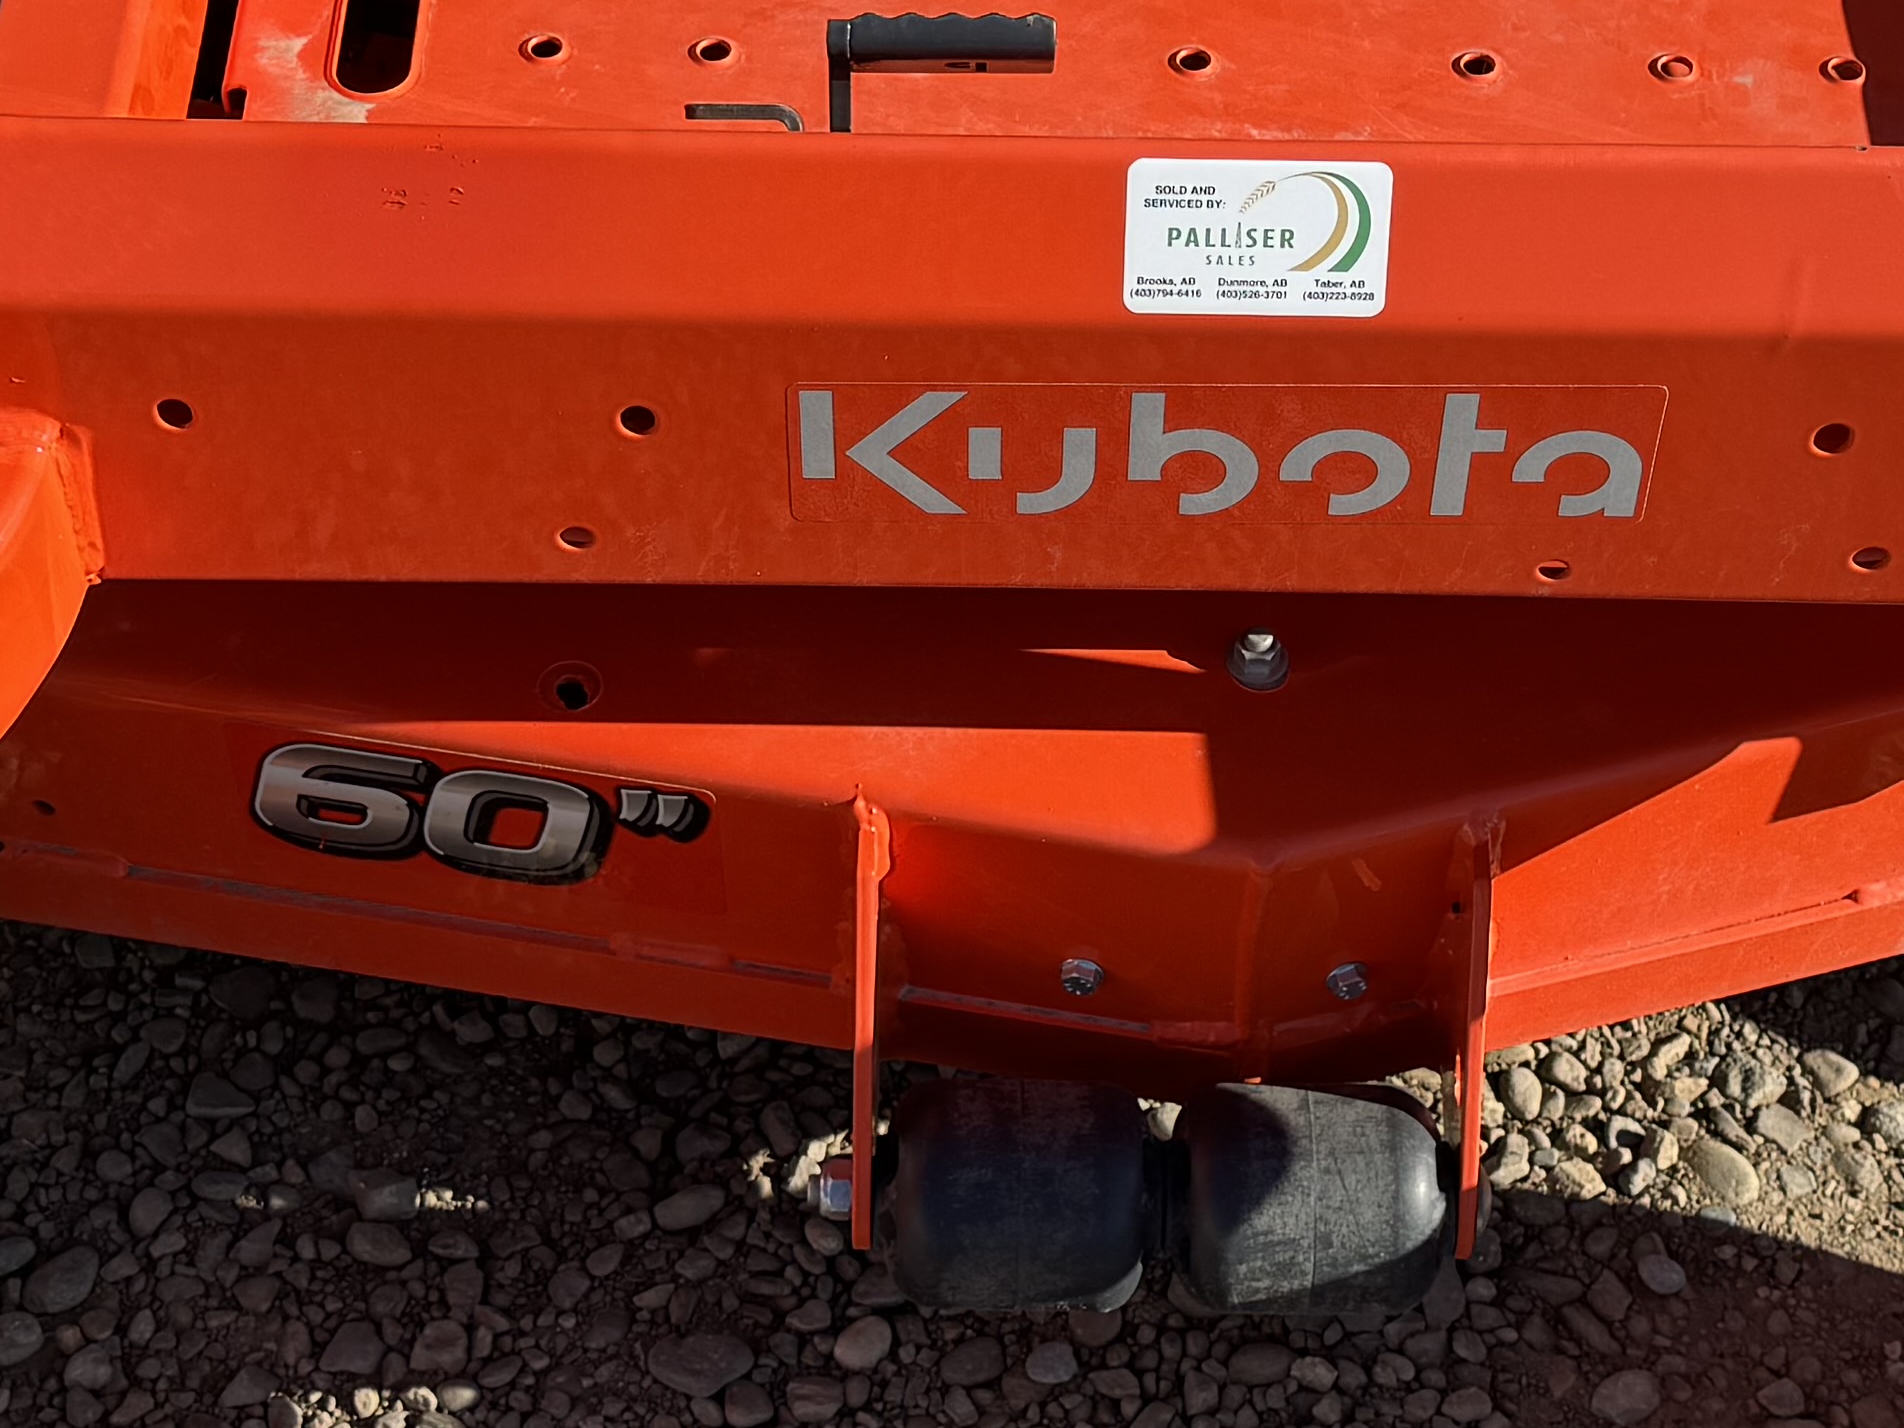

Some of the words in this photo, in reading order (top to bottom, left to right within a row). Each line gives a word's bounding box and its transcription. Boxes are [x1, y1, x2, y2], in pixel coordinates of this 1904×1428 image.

[1155, 185, 1187, 195] SOLD
[1191, 186, 1216, 195] AND
[1144, 198, 1203, 209] SERVICED
[1206, 199, 1226, 209] BY:
[1167, 222, 1295, 249] PALLISER
[1205, 255, 1256, 266] SALES
[1137, 276, 1177, 287] Brooks,
[1180, 277, 1196, 286] AB
[1218, 278, 1268, 289] Dunmore,
[1272, 278, 1288, 287] AB
[1314, 279, 1347, 290] Taber,
[1350, 280, 1365, 289] AB
[797, 390, 1644, 518] Kubota
